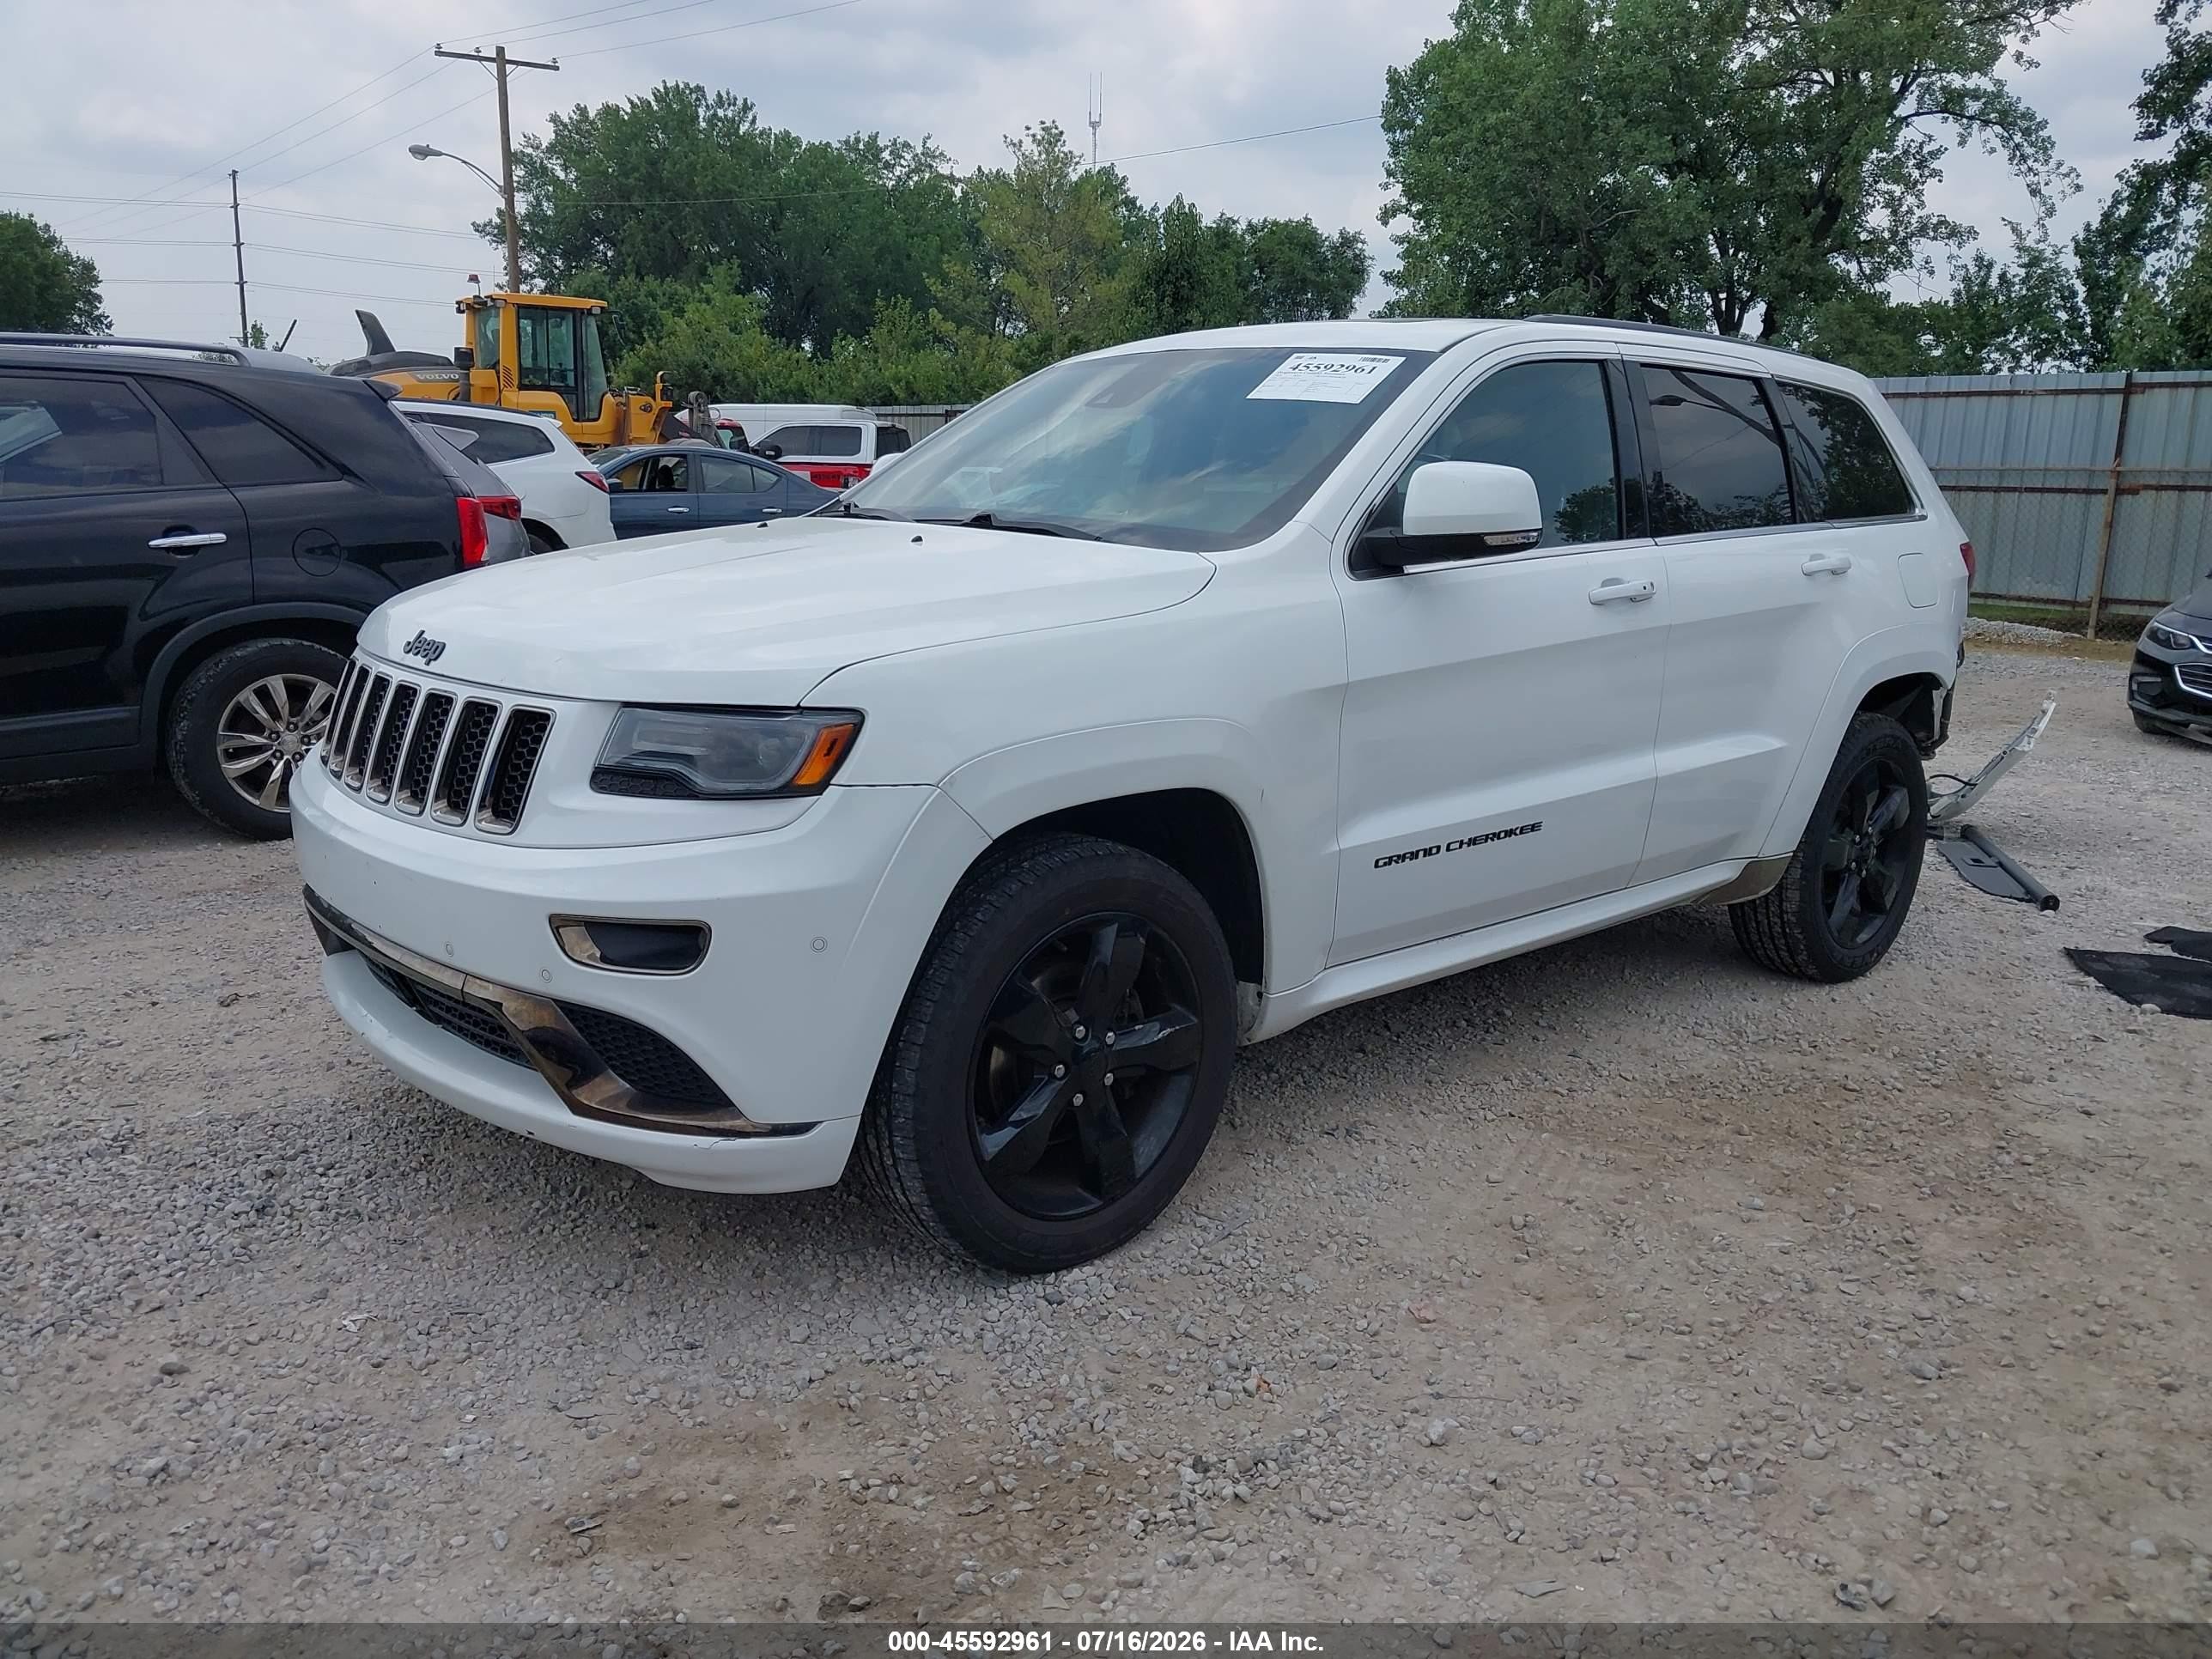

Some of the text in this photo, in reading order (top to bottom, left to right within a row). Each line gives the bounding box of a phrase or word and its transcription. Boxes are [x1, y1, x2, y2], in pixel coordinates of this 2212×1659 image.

[1289, 362, 1377, 374] 45592961
[403, 629, 447, 666] Jeep
[1374, 821, 1543, 869] GRAND CHEROKEE
